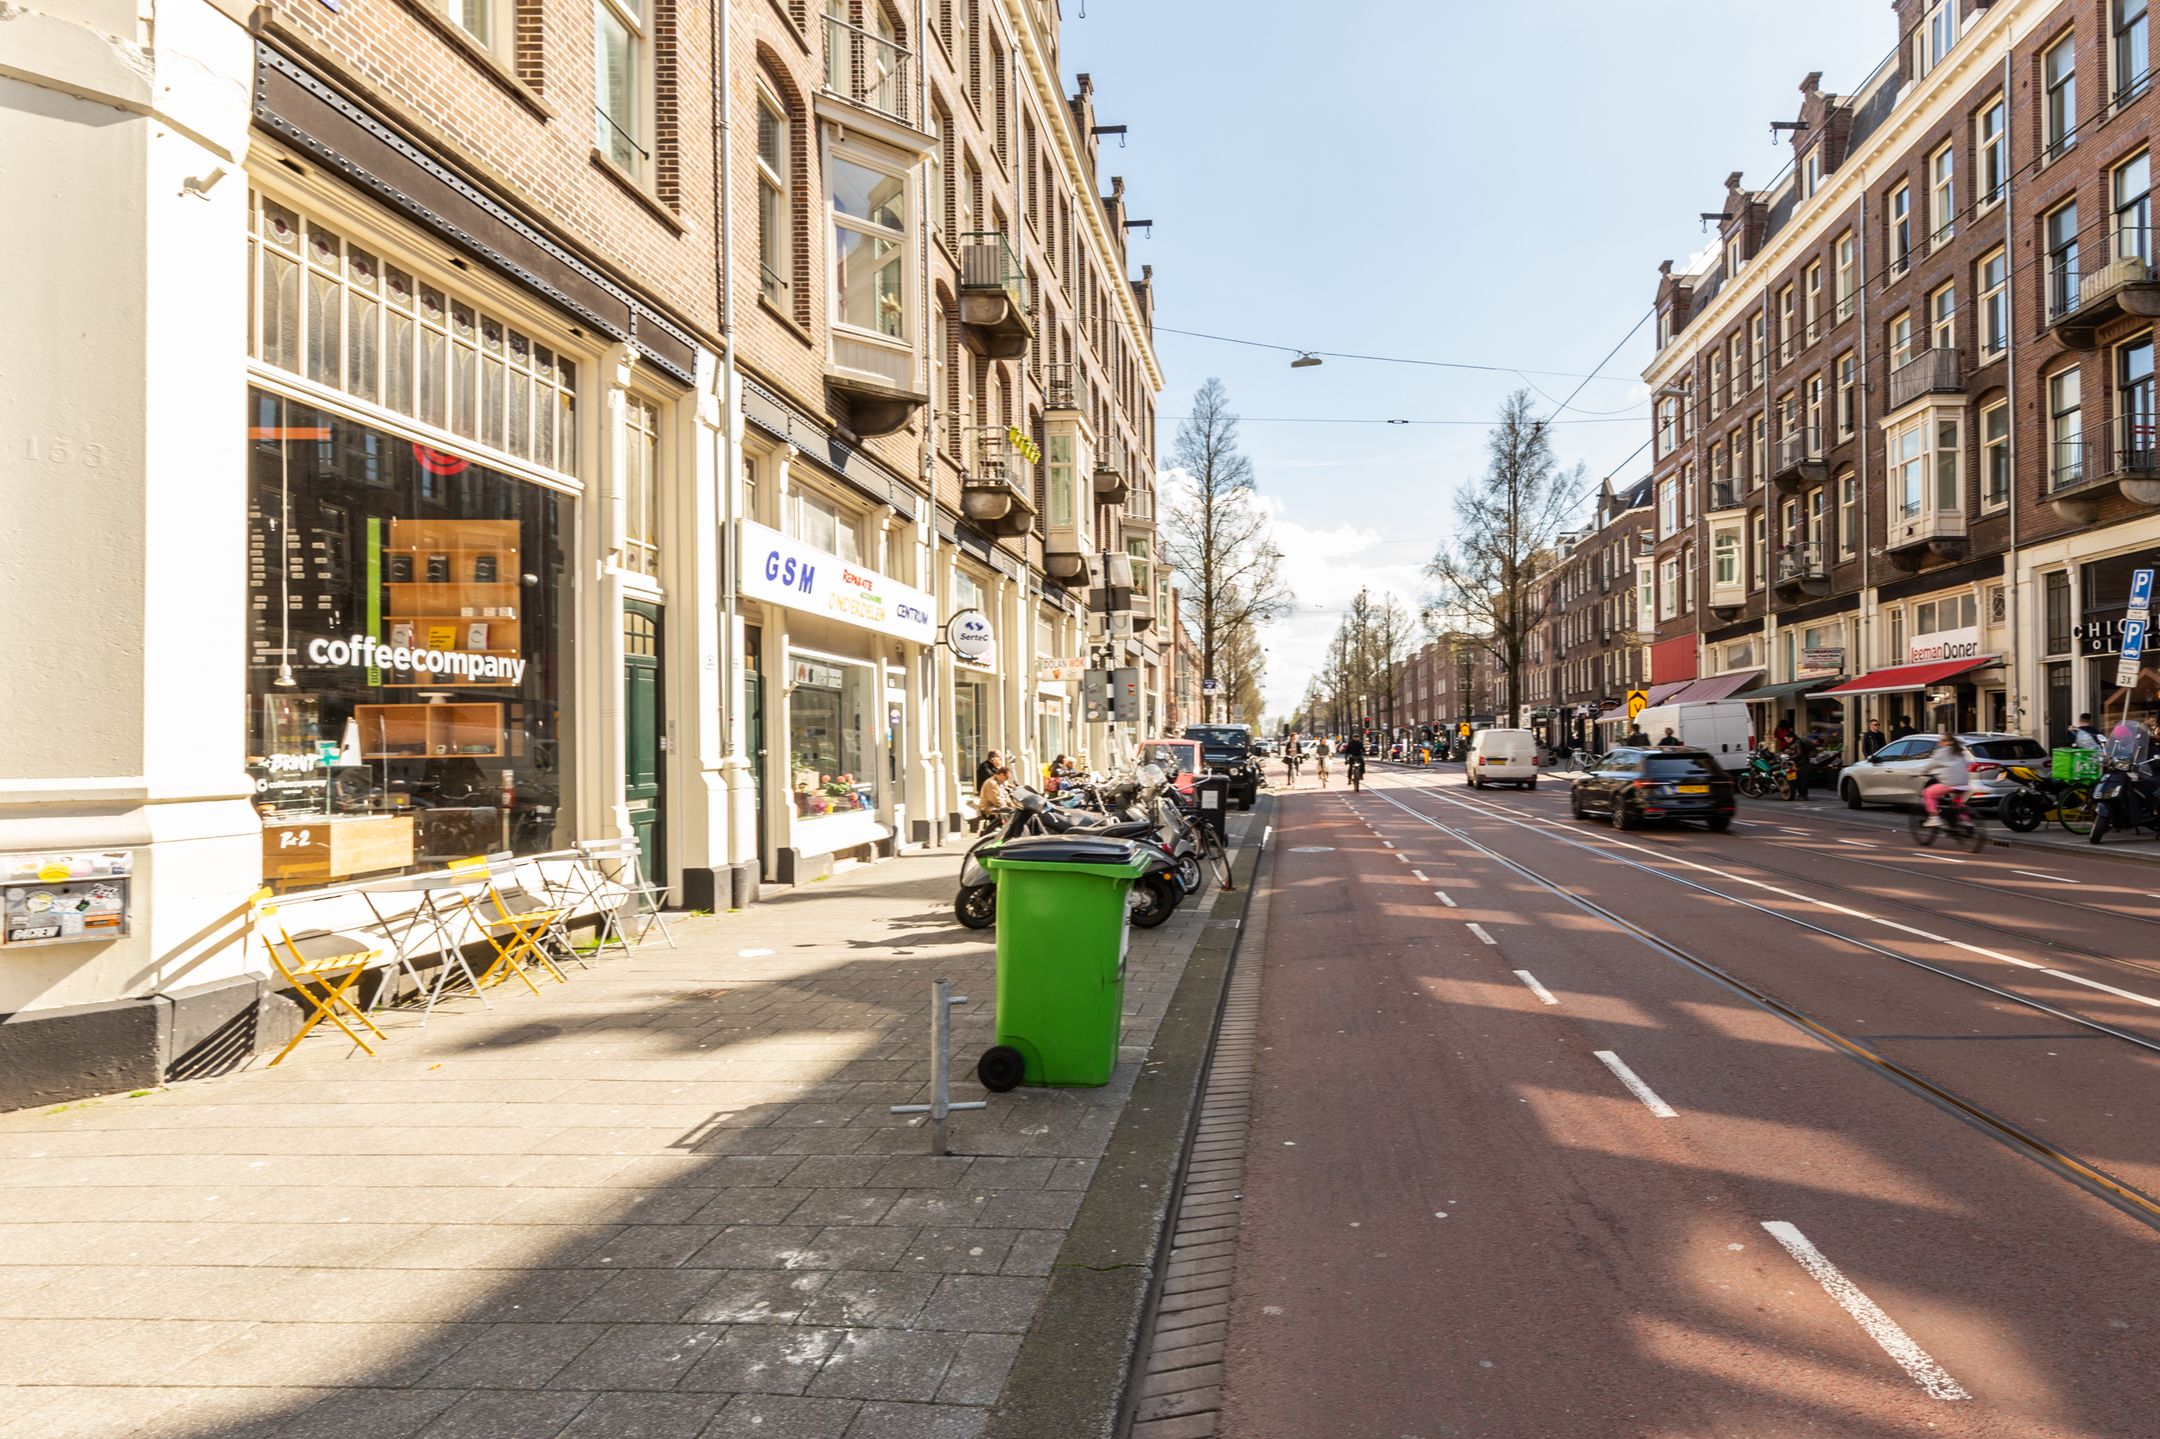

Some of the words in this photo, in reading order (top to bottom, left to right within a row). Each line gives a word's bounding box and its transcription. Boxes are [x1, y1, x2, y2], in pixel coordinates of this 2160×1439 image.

[765, 550, 815, 595] GSM
[2134, 573, 2149, 593] P
[897, 603, 928, 625] CENTRUM
[2127, 623, 2140, 643] P
[308, 634, 525, 685] coffeecompany
[1943, 641, 1978, 660] Doner
